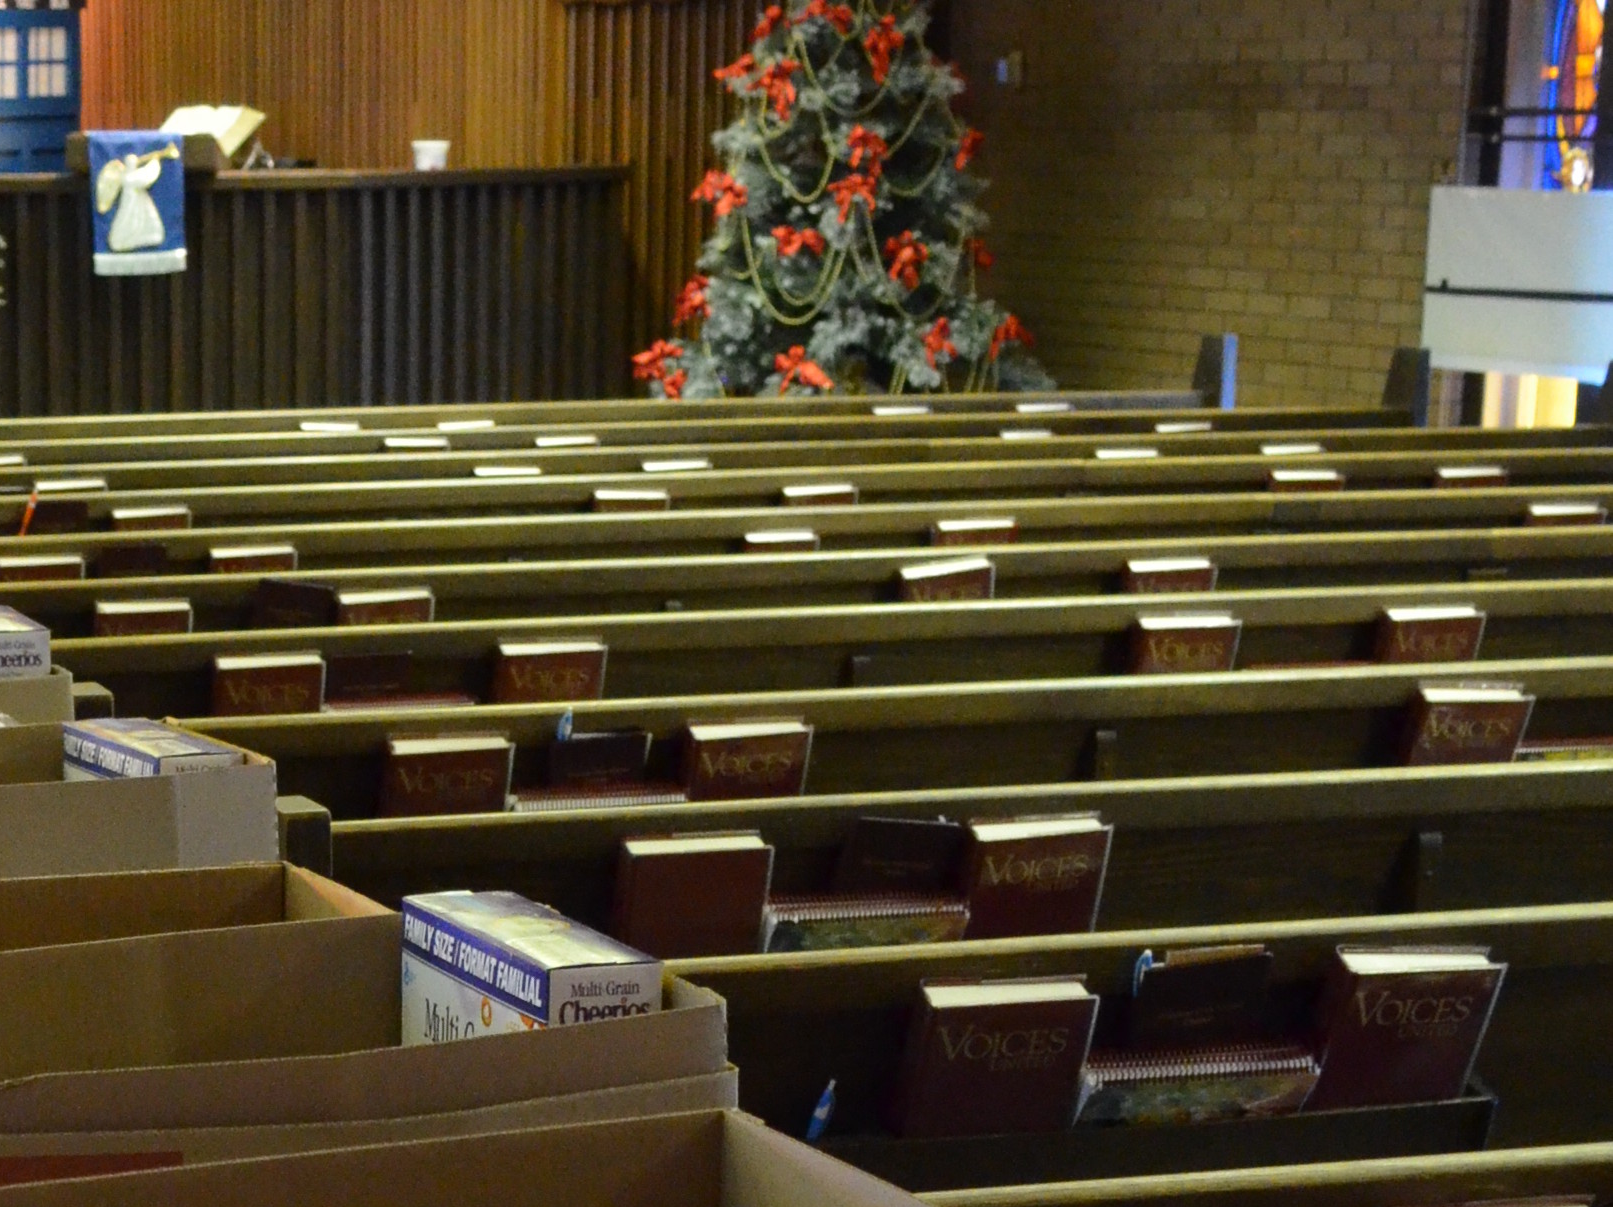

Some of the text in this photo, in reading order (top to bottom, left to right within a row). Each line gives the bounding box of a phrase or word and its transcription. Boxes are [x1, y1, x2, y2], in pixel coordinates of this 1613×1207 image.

[404, 913, 434, 952] FAMILY
[433, 930, 455, 964] SIZE
[458, 941, 497, 985] FORMAT
[496, 960, 542, 1008] FAMILIAL
[1356, 990, 1475, 1028] VOICES
[937, 1024, 1069, 1062] VOICES
